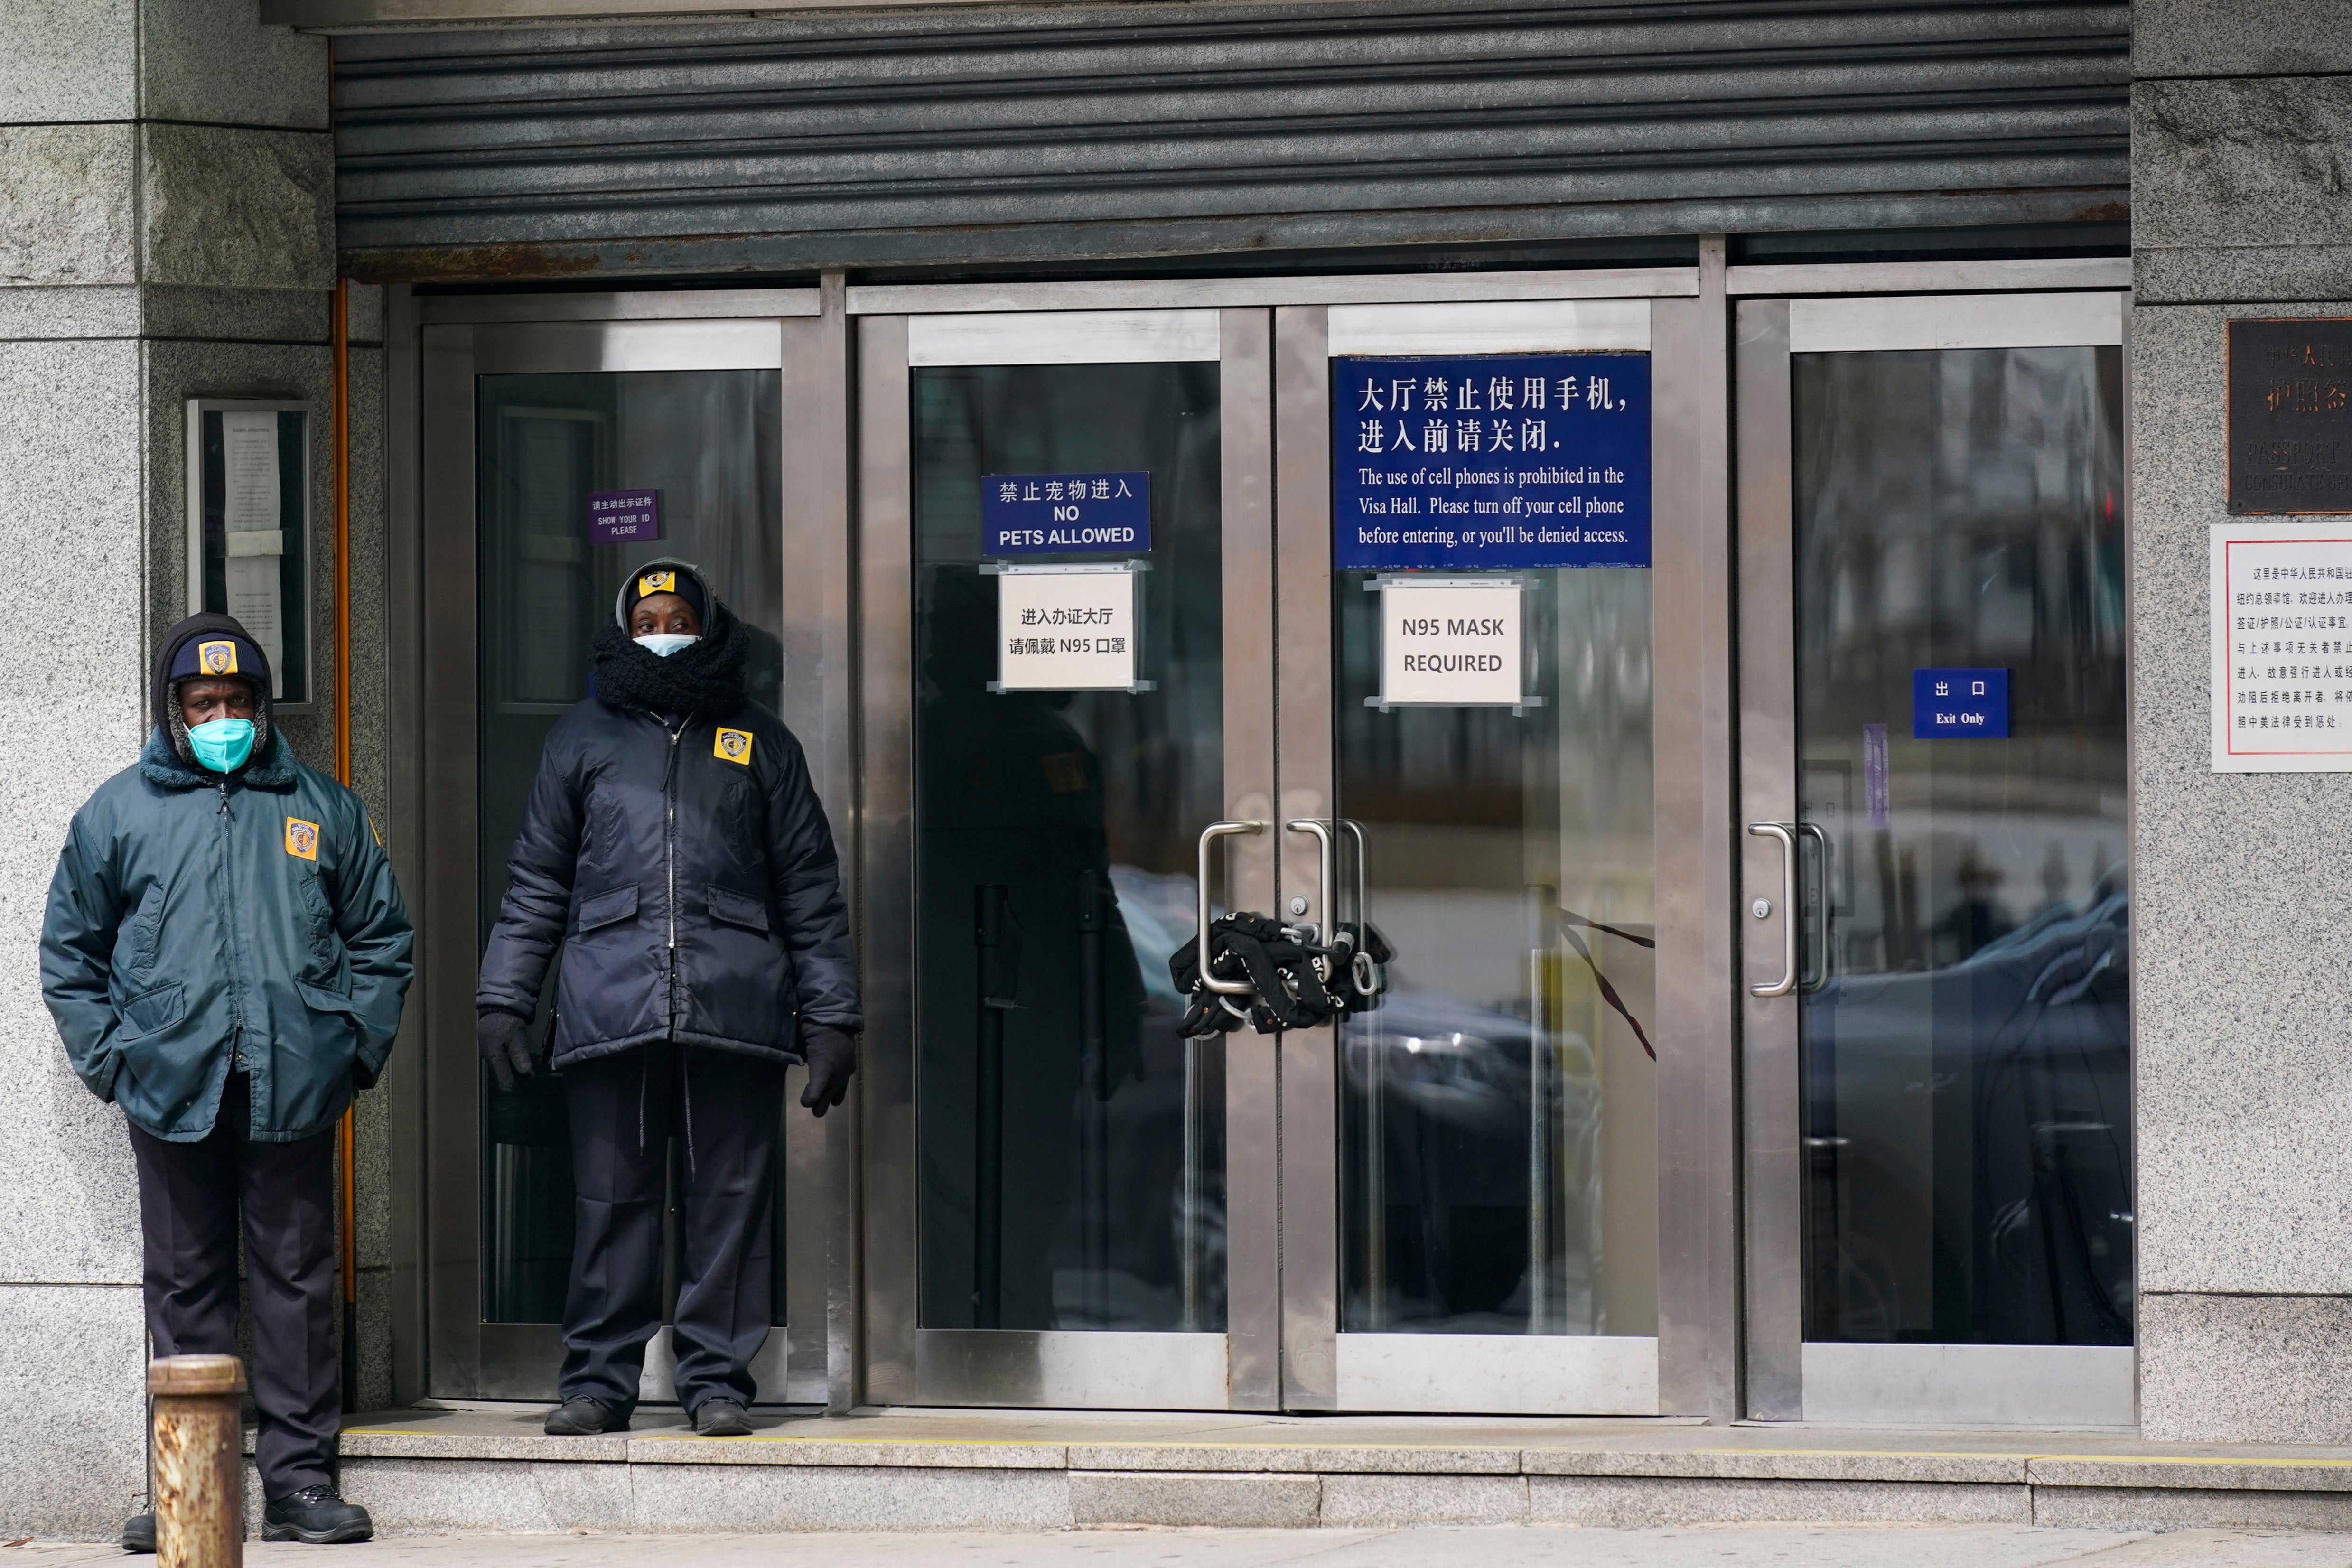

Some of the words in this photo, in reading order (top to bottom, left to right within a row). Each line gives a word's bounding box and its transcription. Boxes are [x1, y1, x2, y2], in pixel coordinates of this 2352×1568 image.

[1359, 376, 1625, 411] 大厅禁止使用手机，
[1359, 468, 1382, 484] The
[1387, 473, 1407, 484] use
[1412, 467, 1426, 484] of
[1429, 467, 1451, 484] cell
[1456, 467, 1499, 488] phones
[1504, 467, 1514, 484] is
[1519, 467, 1584, 488] prohibited
[1588, 467, 1600, 483] in
[1605, 467, 1624, 483] the
[1000, 479, 1132, 503] 禁止宠物进入
[592, 497, 652, 511] 请主动出示证件
[1359, 497, 1386, 514] Visa
[1391, 497, 1420, 513] Hall.
[1430, 497, 1469, 513] Please
[1474, 500, 1499, 513] turn
[1503, 497, 1523, 513] off
[1525, 502, 1554, 517] your
[1559, 496, 1581, 513] cell
[1586, 496, 1624, 517] phone
[598, 516, 616, 525] SHOW
[620, 515, 637, 523] YOUR
[1055, 506, 1079, 521] NO
[611, 526, 637, 535] PLEASE
[1000, 530, 1044, 545] PETS
[1048, 527, 1134, 544] ALLOWED
[1359, 527, 1398, 543] before
[1403, 527, 1457, 548] entering,
[1463, 532, 1475, 543] or
[1480, 526, 1514, 547] you'll
[1519, 526, 1533, 542] be
[1538, 526, 1580, 542] denied
[1584, 531, 1627, 542] access.
[1022, 608, 1113, 625] 进入办证大厅
[1403, 619, 1439, 635] N95
[1448, 619, 1504, 635] MASK
[1009, 638, 1055, 654] 请佩戴
[1061, 639, 1090, 652] N95
[1097, 638, 1125, 653] 口罩
[2238, 641, 2352, 654] 与上述事项无关者禁止
[1405, 655, 1502, 673] REQUIRED
[1935, 681, 1985, 696] 出口
[1937, 713, 1956, 723] Exit
[1961, 713, 1984, 725] Only
